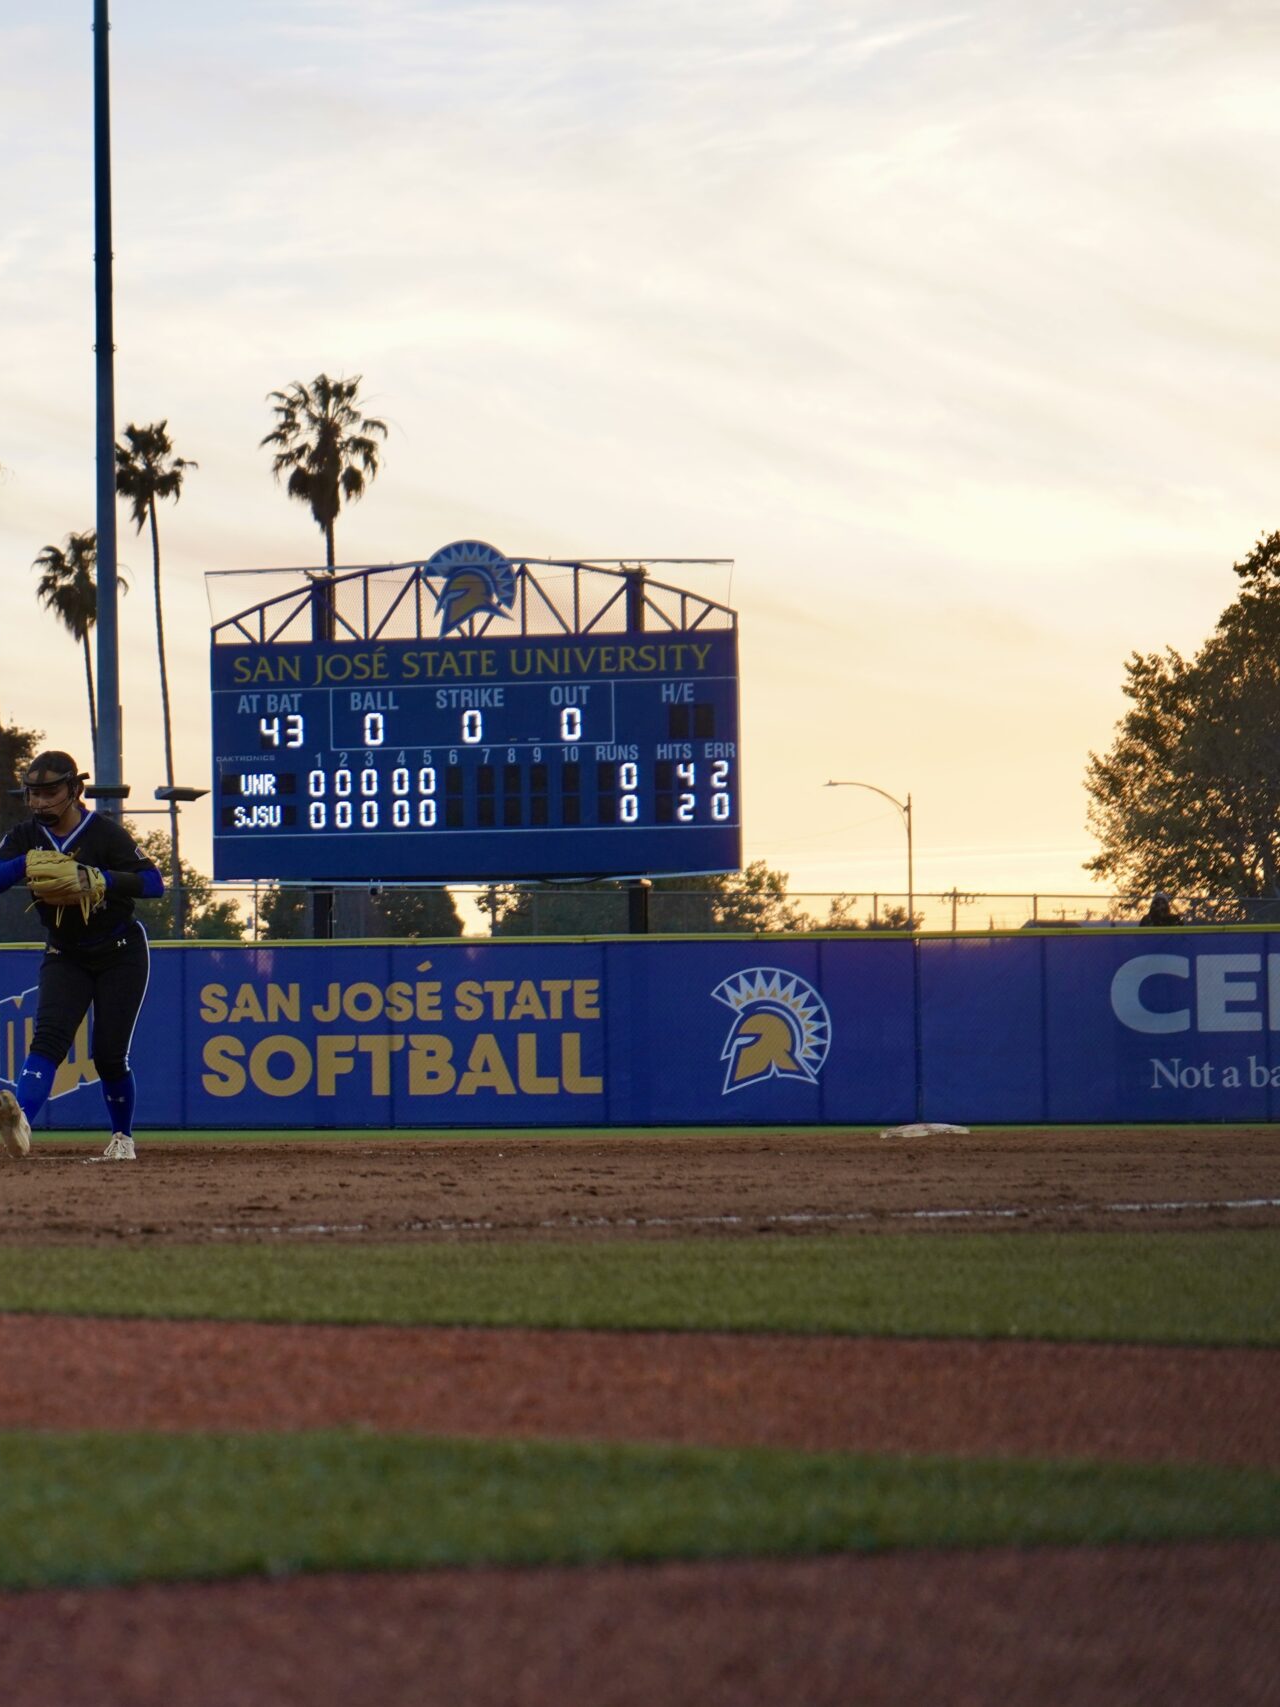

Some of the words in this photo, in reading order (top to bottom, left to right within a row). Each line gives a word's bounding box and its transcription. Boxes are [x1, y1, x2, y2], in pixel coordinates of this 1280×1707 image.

[233, 656, 301, 682] SAN
[312, 646, 389, 686] JOSÉ
[402, 650, 497, 679] STATE
[511, 644, 712, 675] UNIVERSITY
[237, 695, 260, 714] AT
[267, 693, 302, 713] BAT
[350, 691, 399, 711] BALL
[436, 688, 504, 708] STRIKE
[550, 686, 591, 705] OUT
[661, 683, 695, 704] H/E
[260, 714, 304, 748] 43
[364, 713, 384, 746] 0
[462, 710, 482, 743] 0
[561, 707, 582, 741] 0
[314, 753, 321, 767] 1
[339, 752, 348, 767] 2
[365, 751, 374, 767] 3
[397, 751, 406, 765] 4
[423, 750, 432, 765] 5
[449, 749, 458, 764] 6
[482, 749, 491, 764] 7
[507, 748, 516, 763] 8
[533, 747, 542, 763] 9
[562, 746, 579, 762] 10
[595, 744, 639, 761] RUNS
[657, 743, 692, 760] HITS
[704, 742, 736, 758] ERR
[240, 774, 276, 796] UNR
[309, 769, 326, 797] 0
[335, 769, 352, 796] 0
[361, 768, 378, 796] 0
[392, 767, 409, 795] 0
[419, 767, 436, 795] 0
[621, 762, 638, 790] 0
[677, 762, 695, 787] 4
[710, 760, 729, 788] 2
[234, 805, 281, 827] SJSU
[309, 801, 326, 829] 0
[335, 801, 352, 829] 0
[361, 800, 378, 828] 0
[393, 799, 410, 827] 0
[419, 799, 436, 827] 0
[621, 794, 638, 822] 0
[677, 793, 695, 821] 2
[711, 792, 729, 821] 0
[199, 982, 300, 1023] SAN
[311, 960, 443, 1022] JOSÉ
[455, 979, 600, 1021] STATE
[201, 1032, 603, 1097] SOFTBALL
[1149, 1058, 1215, 1089] Not
[1222, 1066, 1241, 1088] a
